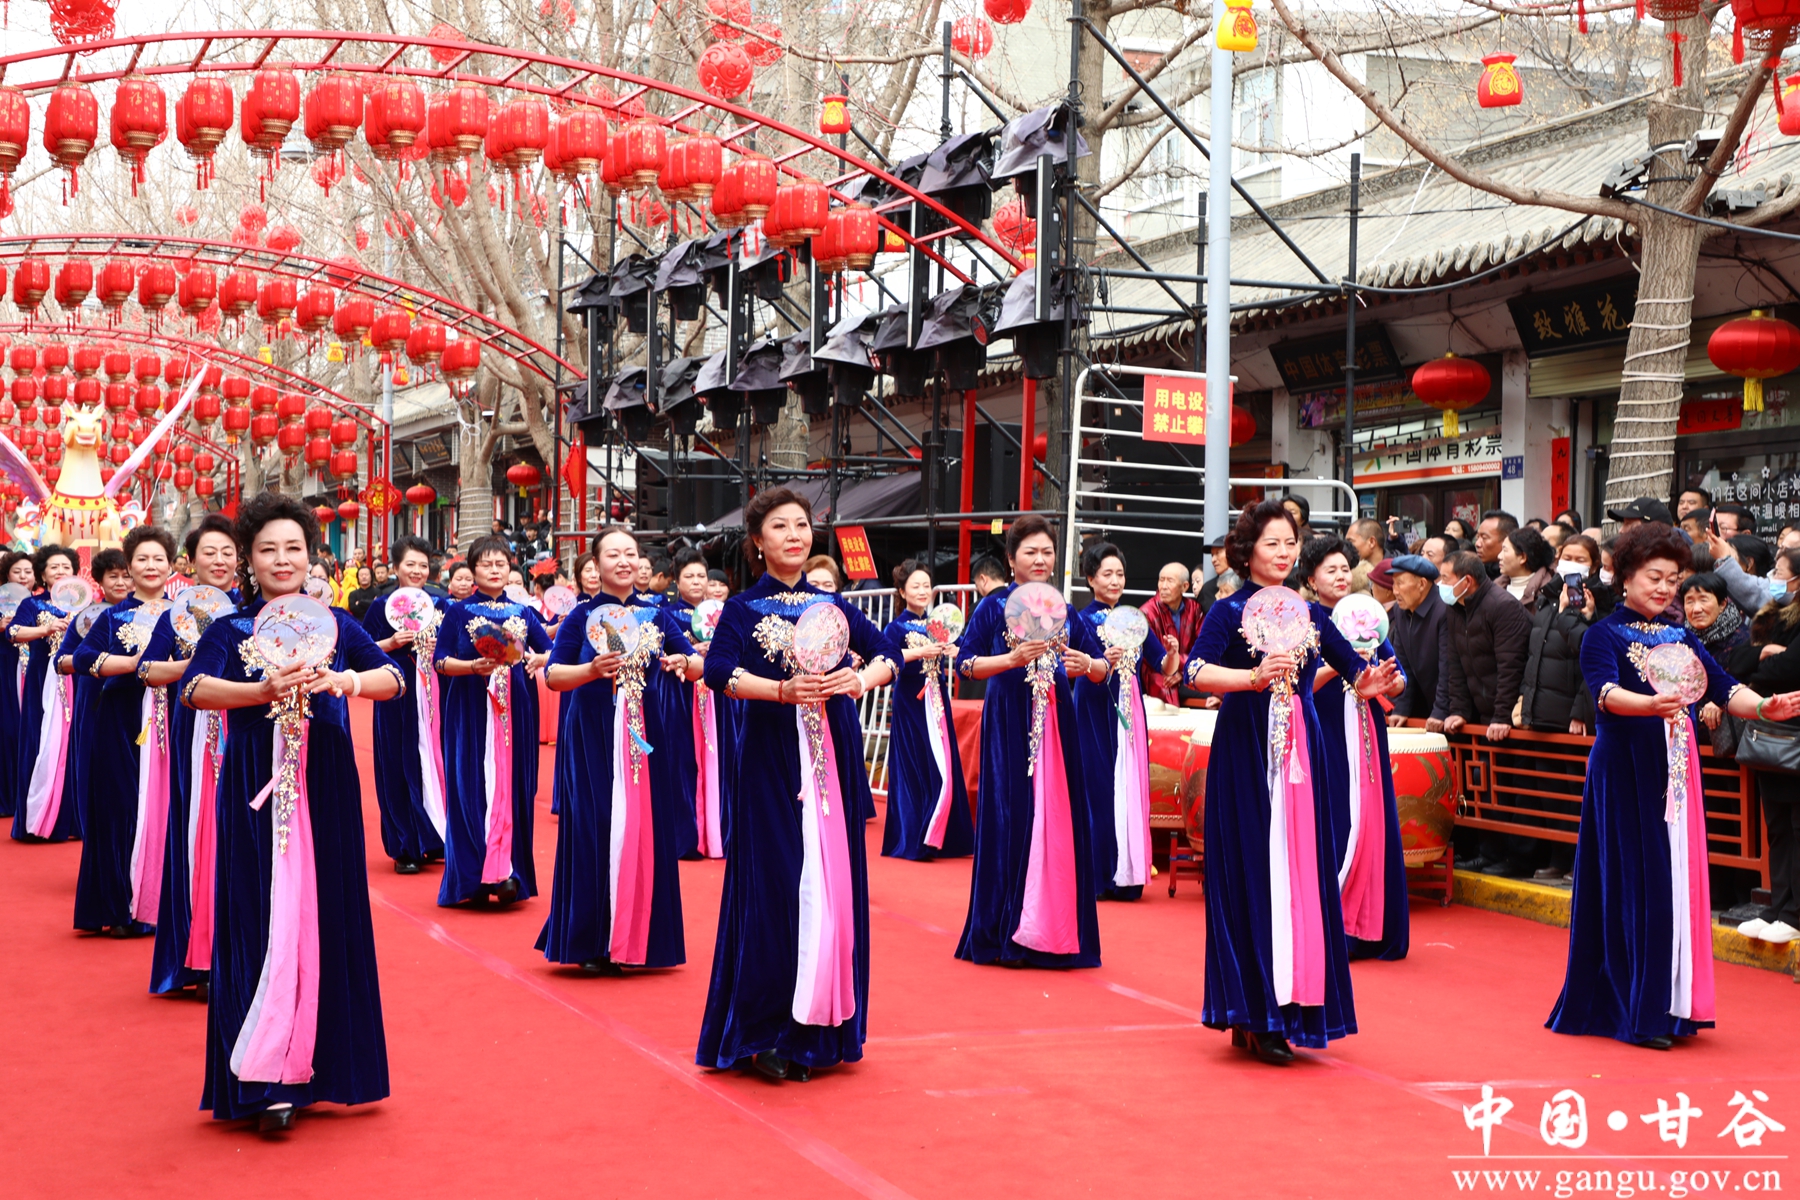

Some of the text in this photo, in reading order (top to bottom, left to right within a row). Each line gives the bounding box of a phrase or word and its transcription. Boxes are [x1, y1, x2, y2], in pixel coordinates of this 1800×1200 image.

[1533, 290, 1639, 340] 致雅花
[1283, 340, 1389, 381] 中国体育彩票
[1154, 388, 1206, 412] 用电设
[1153, 412, 1206, 436] 禁止攀
[1387, 433, 1502, 466] 中国体育彩票
[1507, 464, 1516, 475] 48
[1706, 480, 1788, 503] 们在这间小店
[1745, 501, 1800, 520] 你温暖相
[1761, 523, 1778, 533] small
